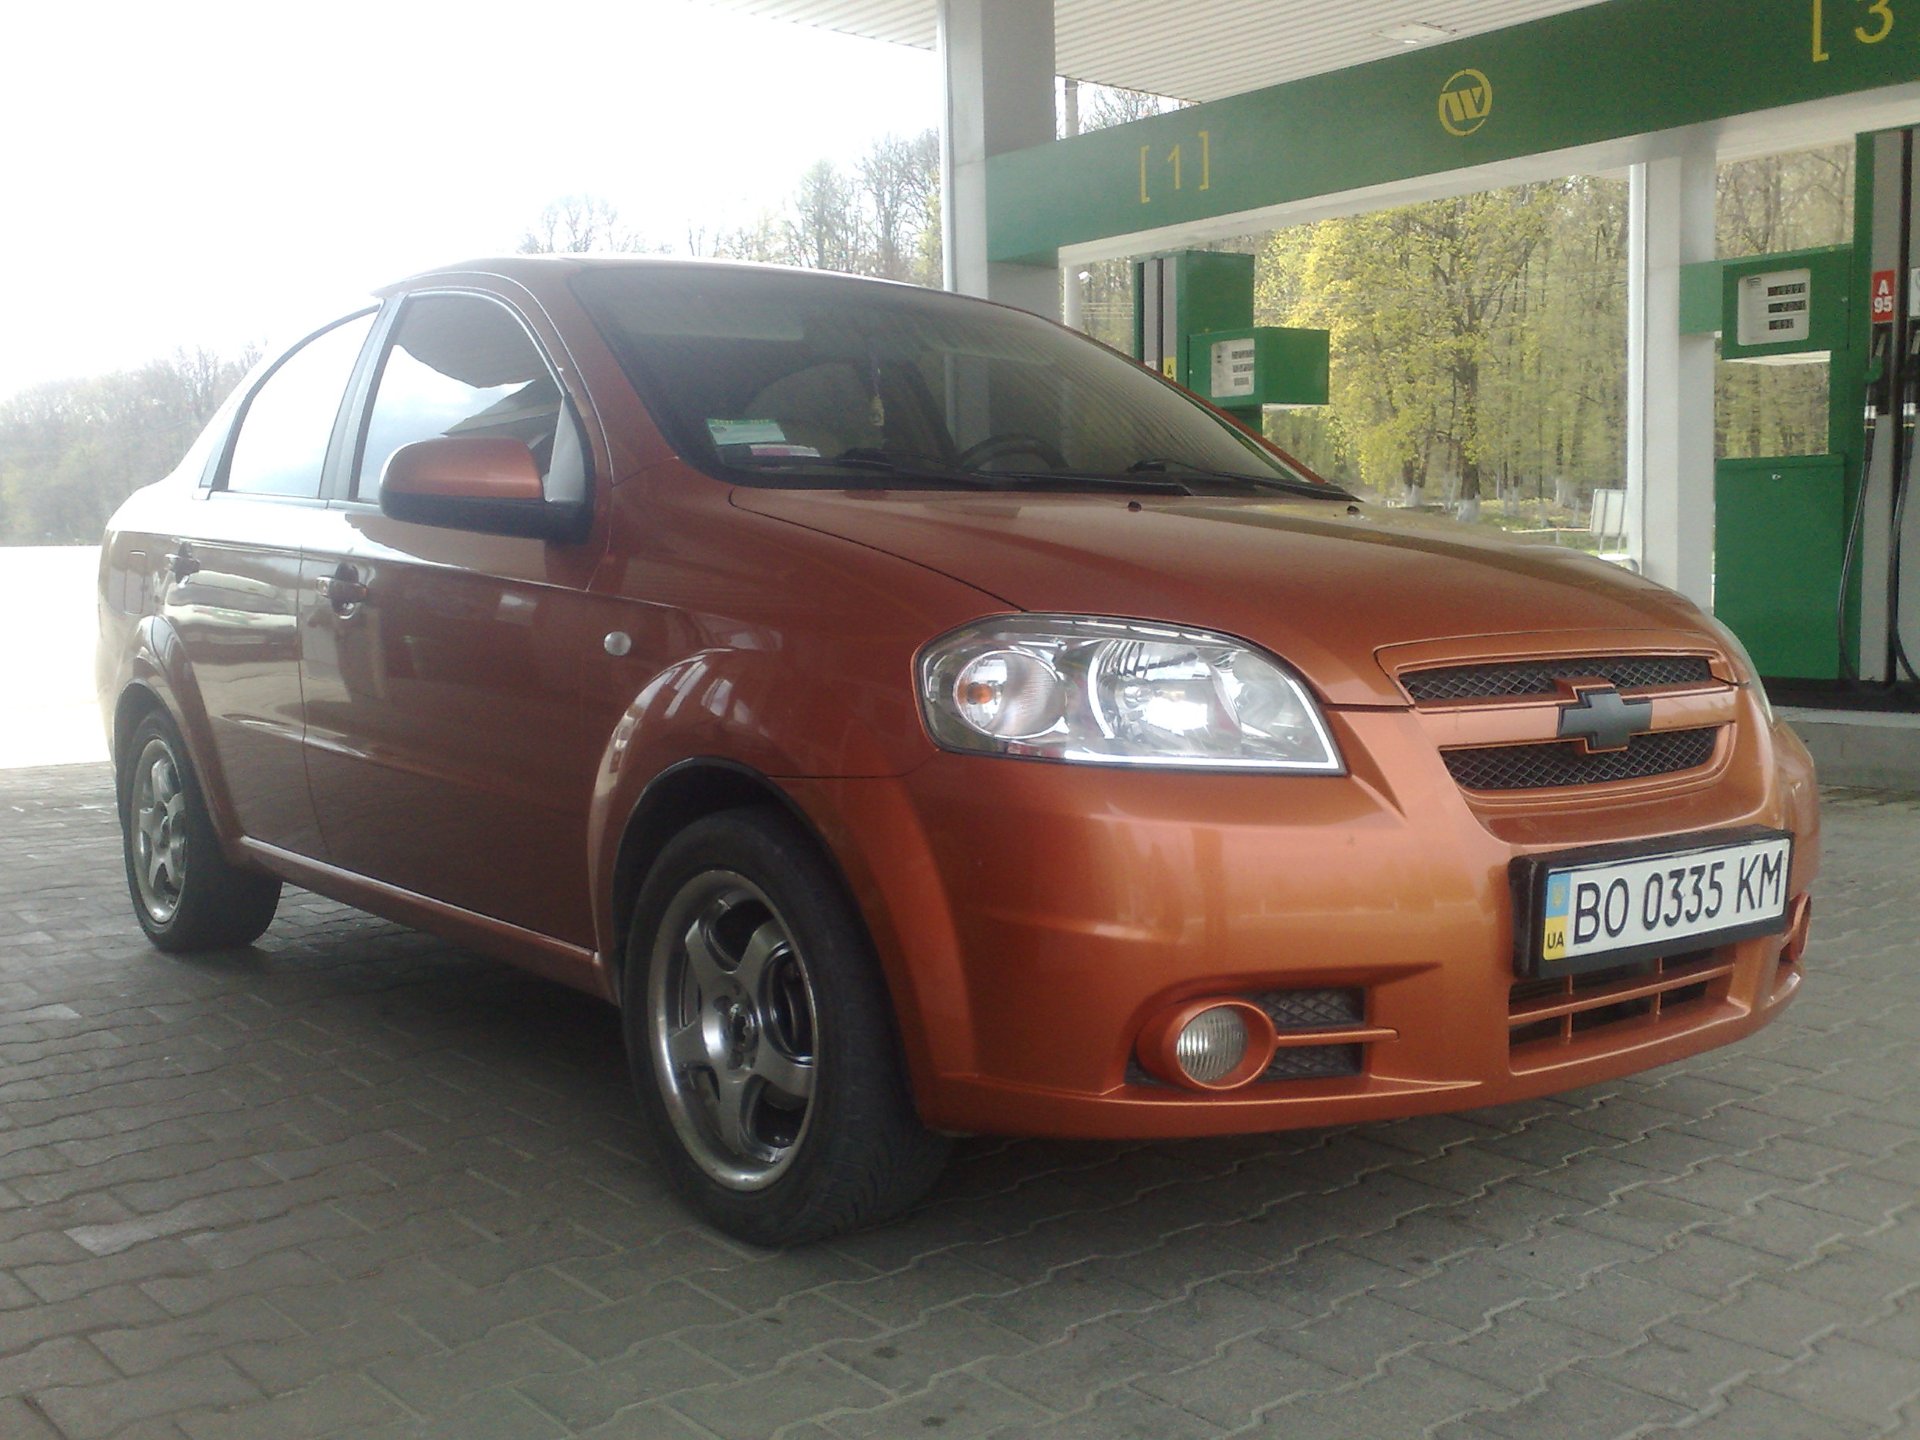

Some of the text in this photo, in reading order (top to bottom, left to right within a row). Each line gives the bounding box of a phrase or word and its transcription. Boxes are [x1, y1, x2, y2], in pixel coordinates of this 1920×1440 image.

[1878, 279, 1889, 295] A
[1873, 295, 1893, 313] 95
[1573, 850, 1784, 945] BO 0335 KM
[1547, 931, 1564, 949] UA
